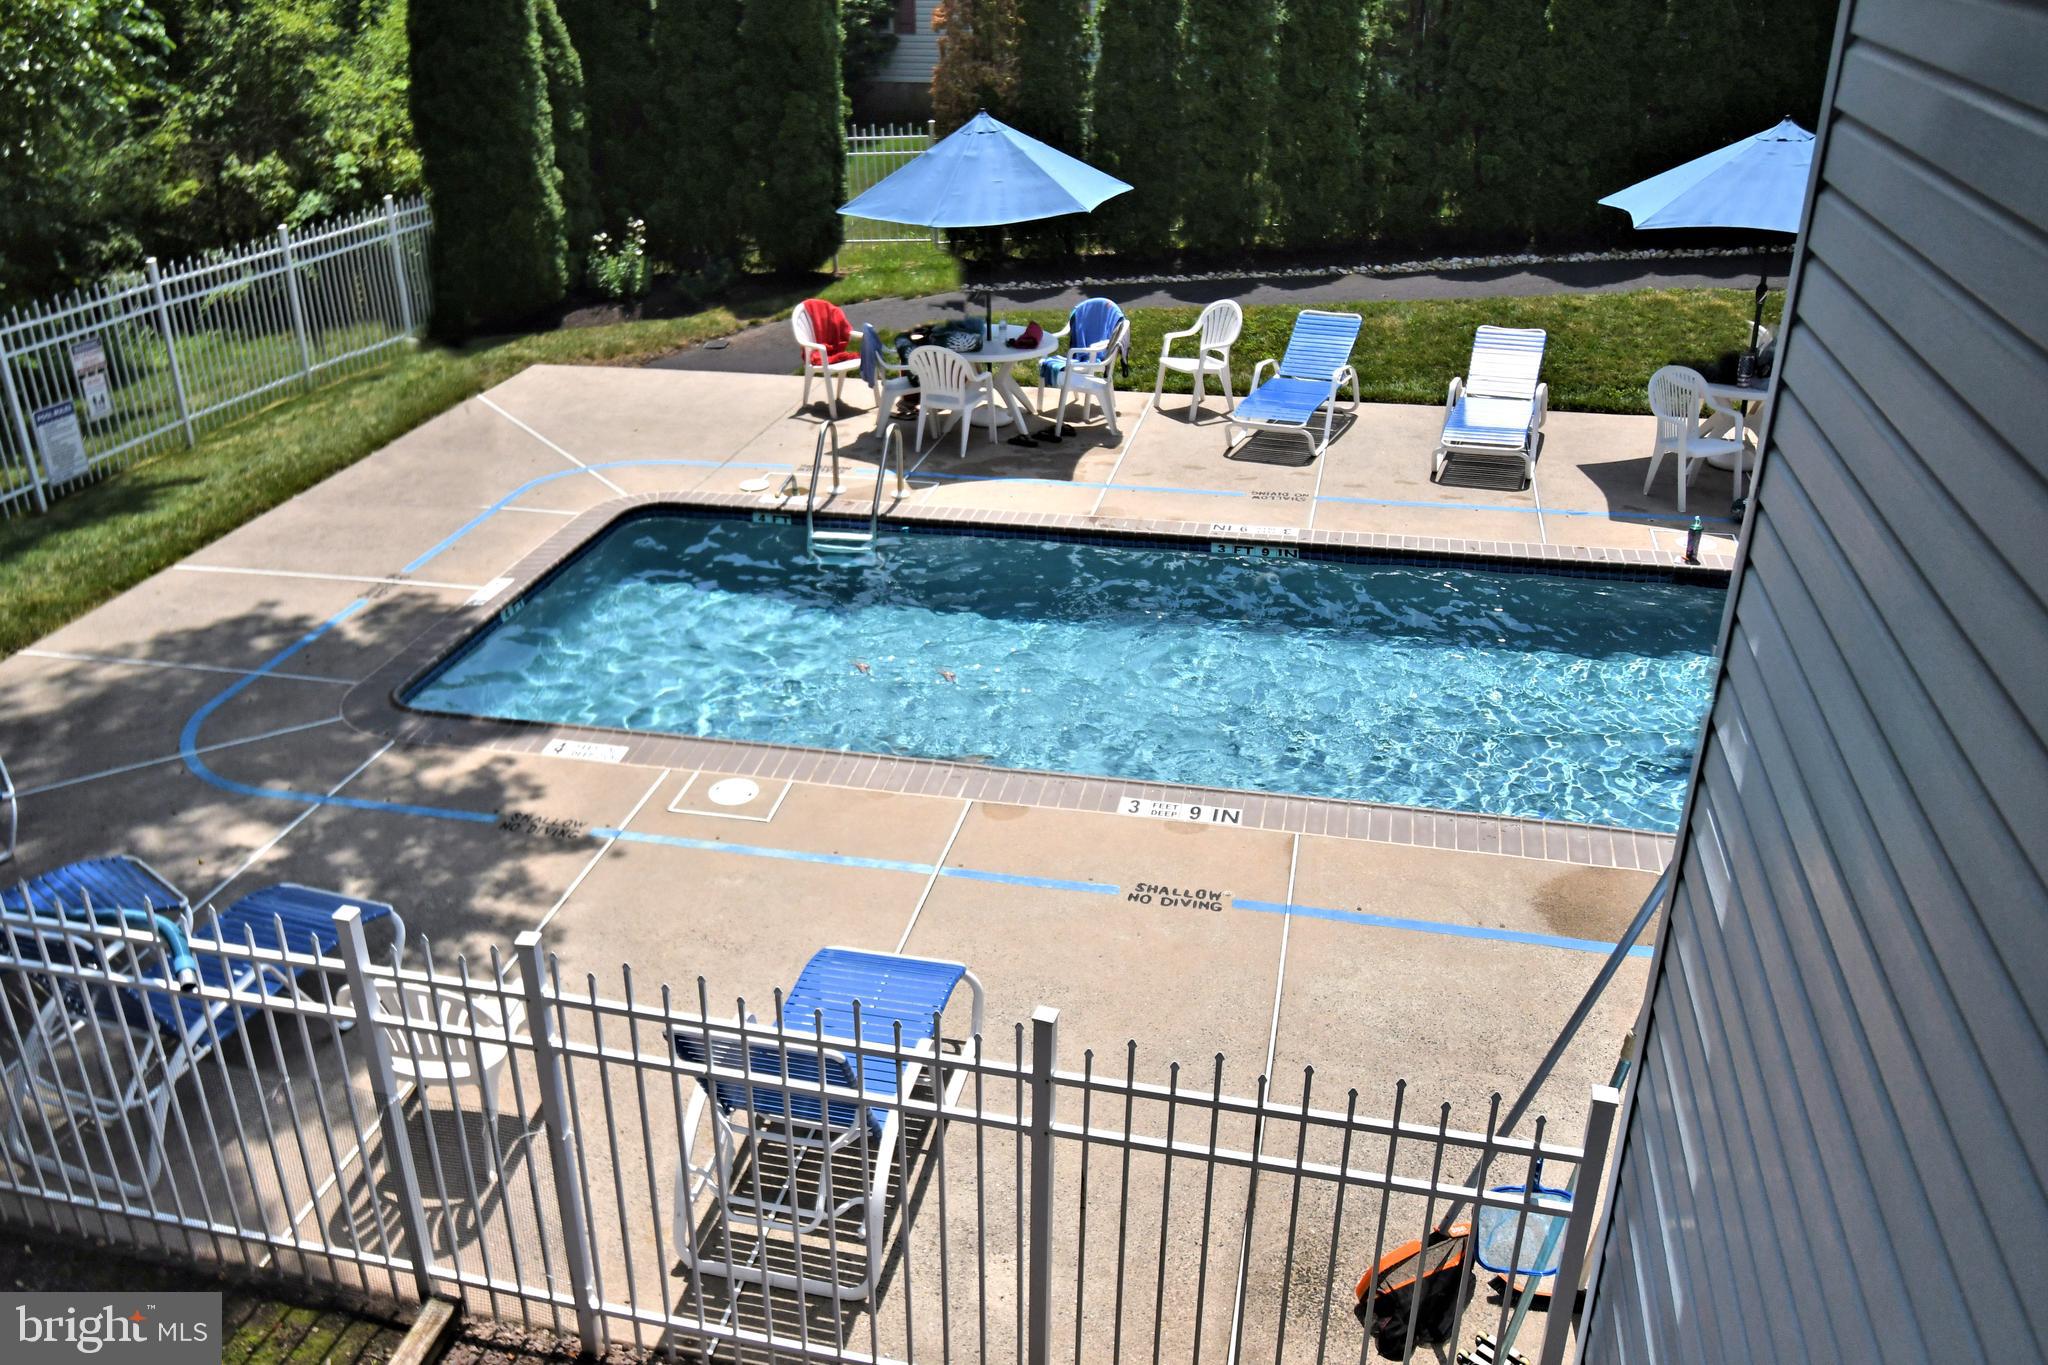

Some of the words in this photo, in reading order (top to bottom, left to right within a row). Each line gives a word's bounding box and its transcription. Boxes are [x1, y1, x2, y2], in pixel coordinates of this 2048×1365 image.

[1218, 545, 1226, 553] 3
[1234, 545, 1254, 555] FT
[1262, 547, 1270, 556] 9
[1279, 548, 1298, 558] IN
[510, 812, 588, 829] SHALLOW
[1128, 800, 1141, 814] 3
[1152, 802, 1179, 811] FEET
[1189, 806, 1202, 820] 9
[1212, 808, 1240, 824] IN
[499, 821, 521, 834] NO
[526, 824, 581, 840] DIVING
[1135, 883, 1222, 901] SHALLOW
[1127, 893, 1153, 905] NO
[1160, 896, 1223, 912] DIVING
